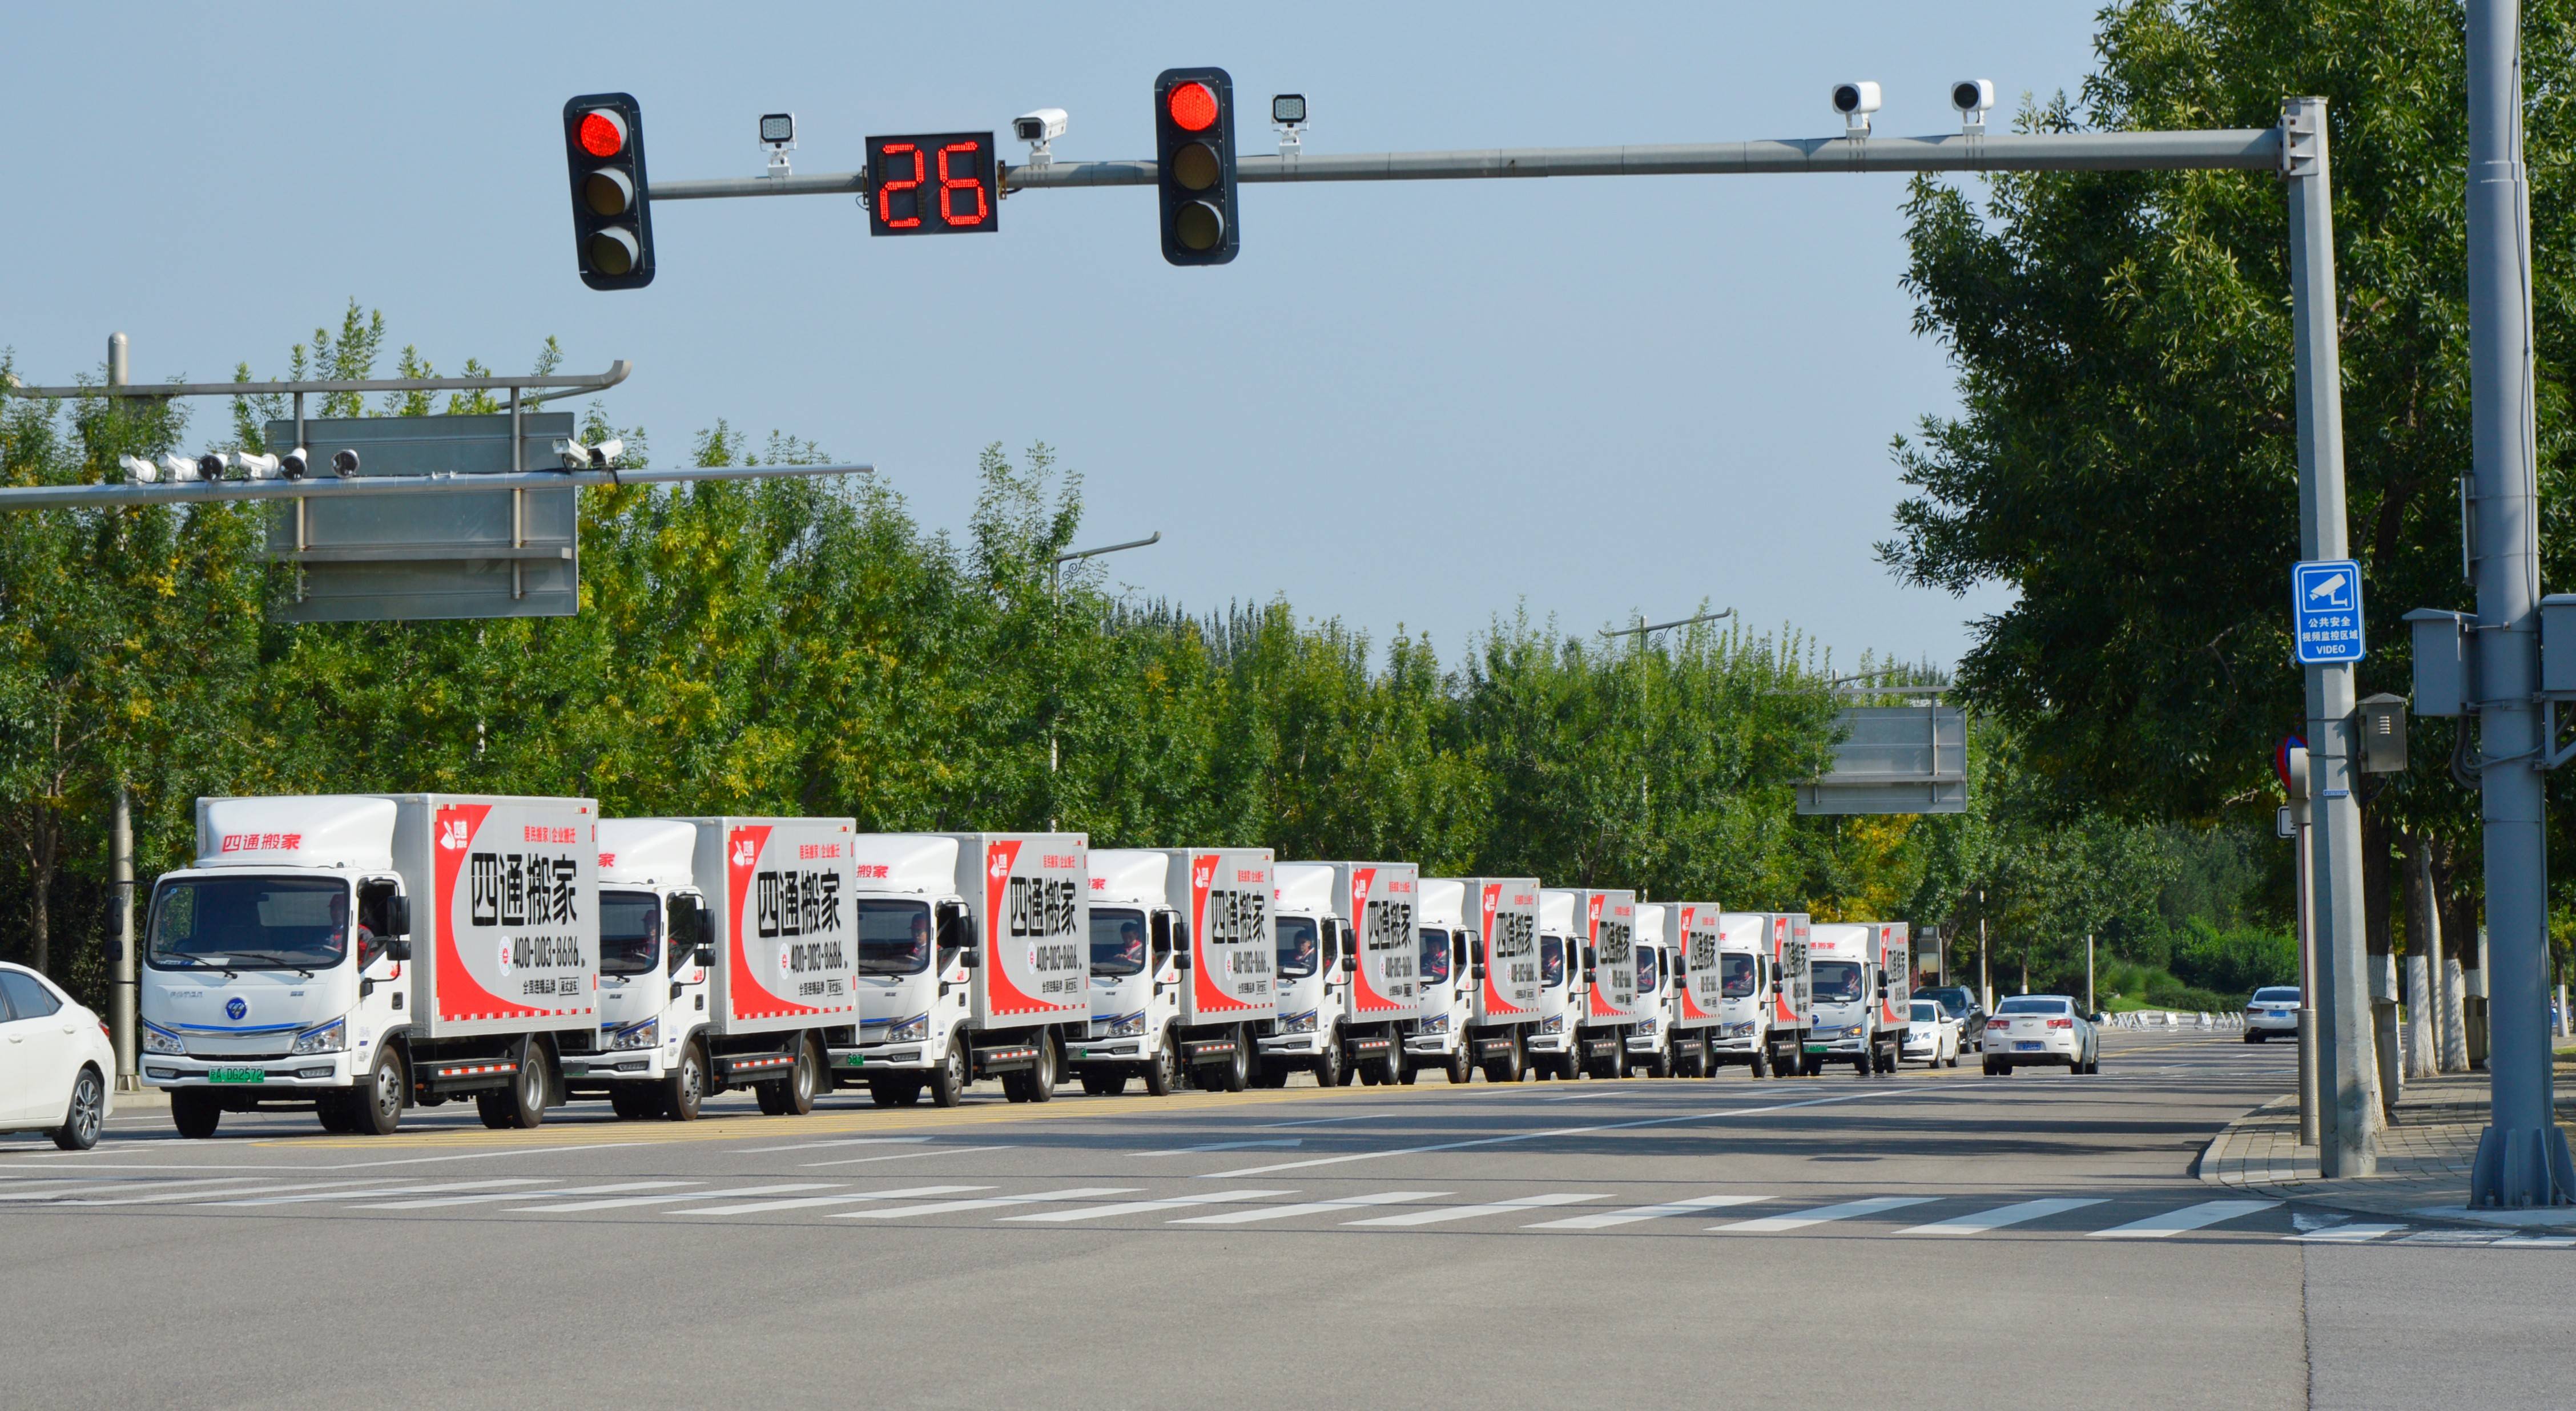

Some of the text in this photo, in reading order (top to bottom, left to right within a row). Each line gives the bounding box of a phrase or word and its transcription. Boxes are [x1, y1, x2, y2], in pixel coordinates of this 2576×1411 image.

[879, 142, 987, 227] 26
[2302, 629, 2358, 643] 视频监控区域
[2308, 616, 2350, 628] 公共安全
[2316, 644, 2346, 655] VIDEO
[222, 833, 302, 853] 四通搬家
[472, 853, 577, 926] 四通搬家
[758, 868, 840, 938] 四通搬家
[1011, 877, 1076, 937] 四通搬家
[1211, 890, 1265, 944] 四通搬家
[1368, 900, 1411, 950] 四通搬家
[1496, 912, 1533, 958] 四通搬家
[513, 936, 579, 969] 400-003-8686
[791, 941, 842, 973] 400-003-8686
[1036, 944, 1077, 972] 400-003-8686
